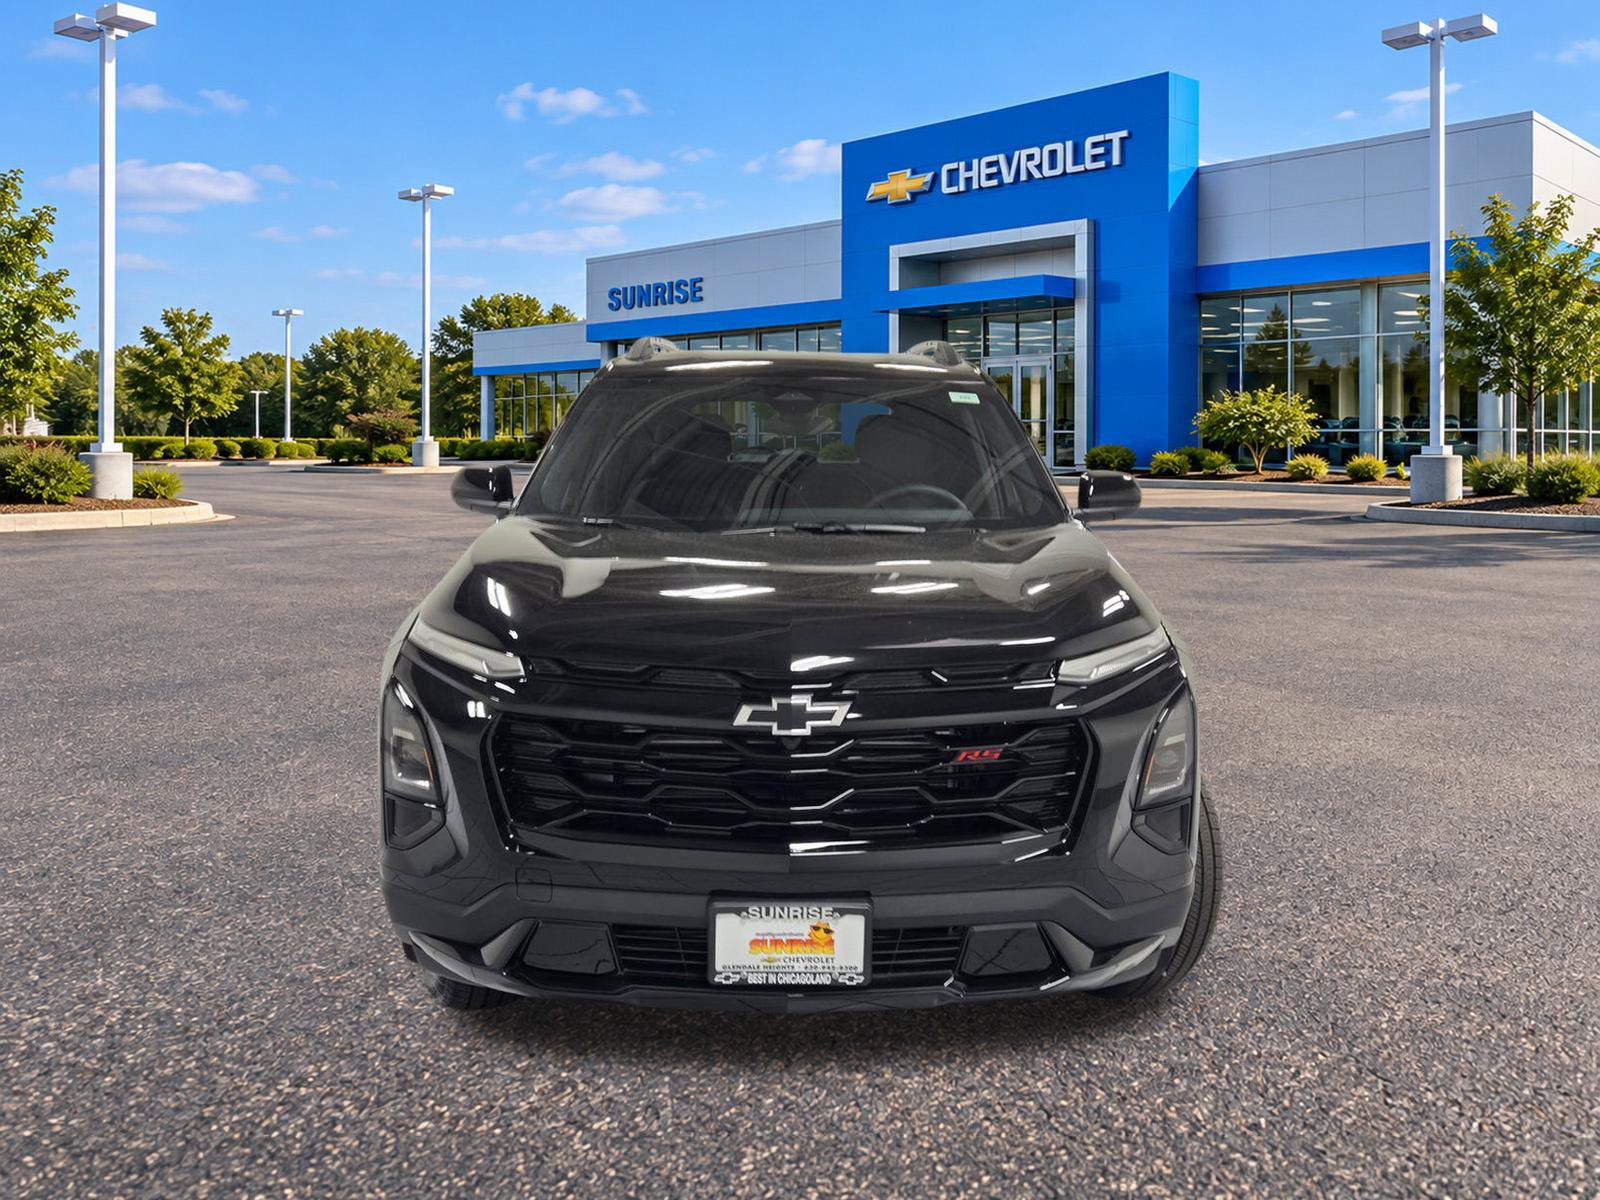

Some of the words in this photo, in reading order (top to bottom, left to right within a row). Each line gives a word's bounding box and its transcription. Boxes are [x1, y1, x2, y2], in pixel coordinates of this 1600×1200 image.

[941, 130, 1129, 195] CHEVROLET
[607, 277, 704, 312] SUNRISE
[956, 750, 1001, 762] RS
[747, 906, 833, 919] SUNRISE
[749, 938, 835, 955] SUNRISE
[783, 956, 834, 964] CHEVROLET
[747, 972, 767, 985] BEST
[767, 972, 777, 985] IN
[777, 972, 831, 985] CHICAGOLAND
